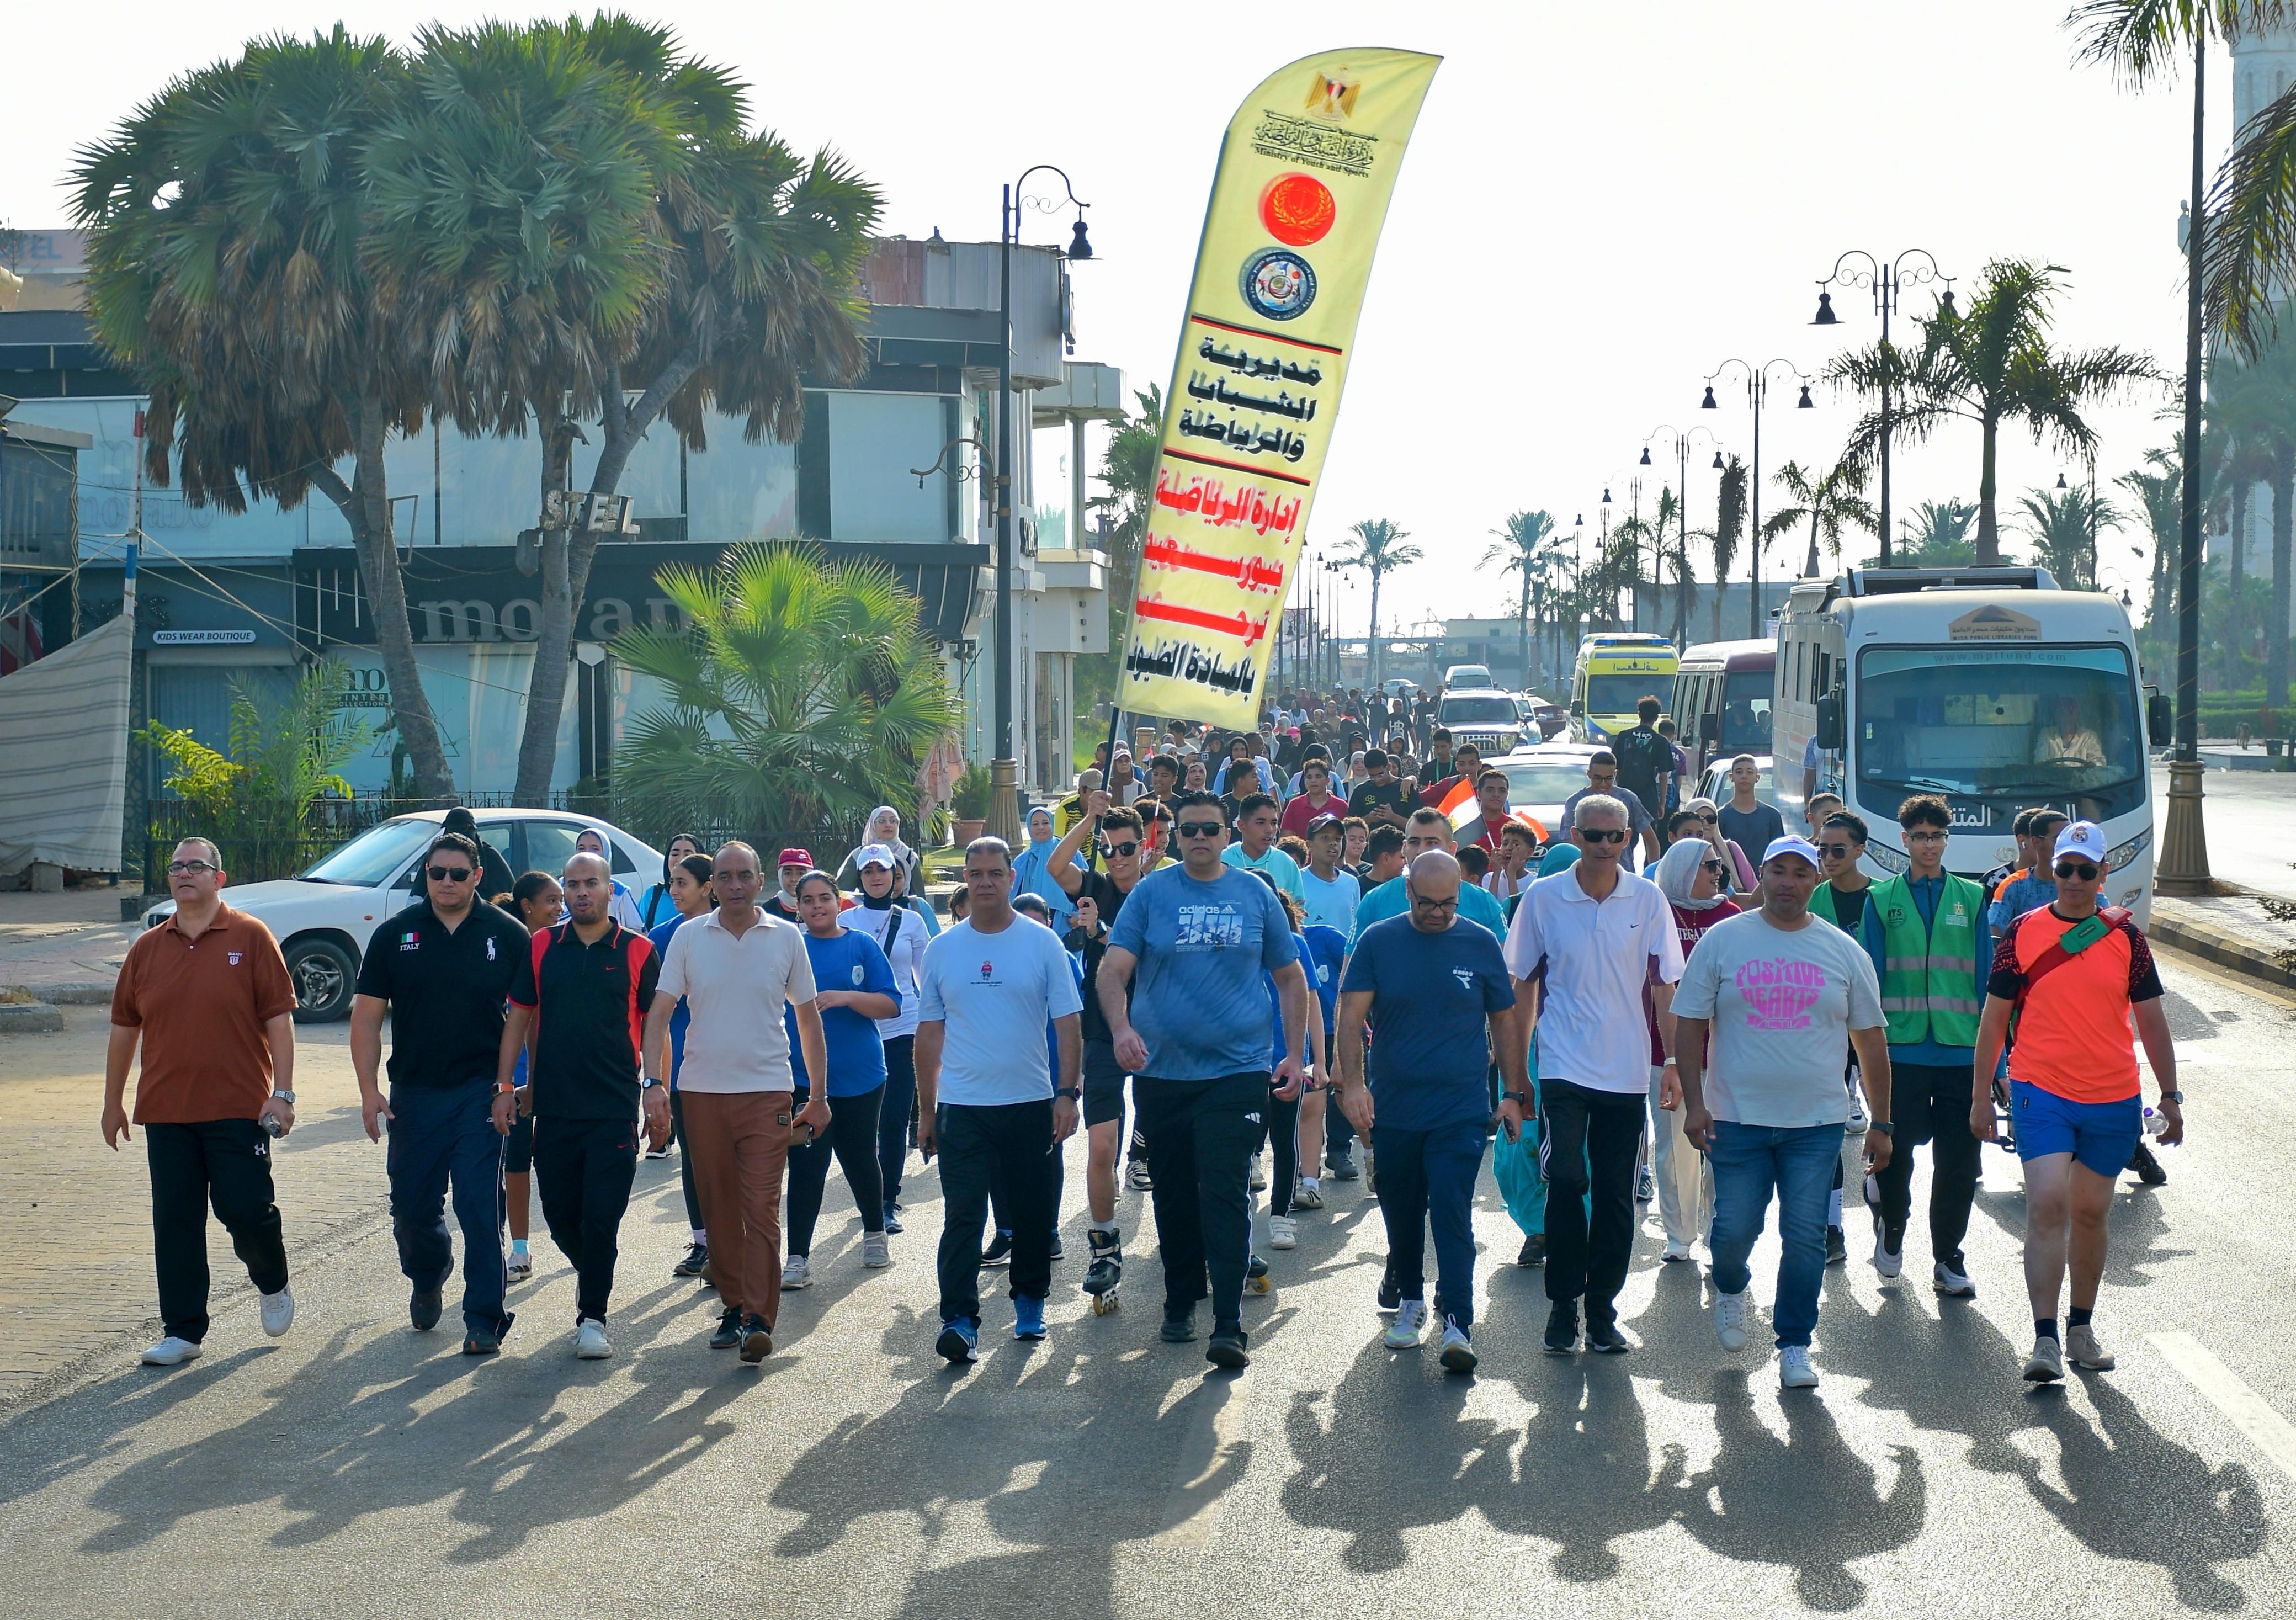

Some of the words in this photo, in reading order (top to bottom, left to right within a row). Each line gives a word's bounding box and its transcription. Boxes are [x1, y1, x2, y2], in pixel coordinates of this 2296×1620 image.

[1254, 146, 1288, 162] Ministry
[1290, 156, 1300, 164] of
[1300, 157, 1325, 169] Youth
[1325, 164, 1342, 172] and
[1342, 166, 1369, 178] Sports
[1199, 336, 1323, 387] مديرية
[1187, 378, 1317, 423] الشباب
[1179, 408, 1305, 463] والرياضة
[1155, 468, 1252, 527] الرياضة
[1251, 490, 1301, 545] إدارة
[1143, 532, 1284, 596] ببورسعيد
[206, 632, 252, 640] BOUTIQUE
[1135, 592, 1270, 648] ترحب
[1184, 646, 1256, 703] بالسادة
[1947, 804, 1991, 827] المتن
[1178, 904, 1220, 914] adidas
[400, 943, 420, 952] ITALY
[1740, 985, 1821, 1018] HEARTS
